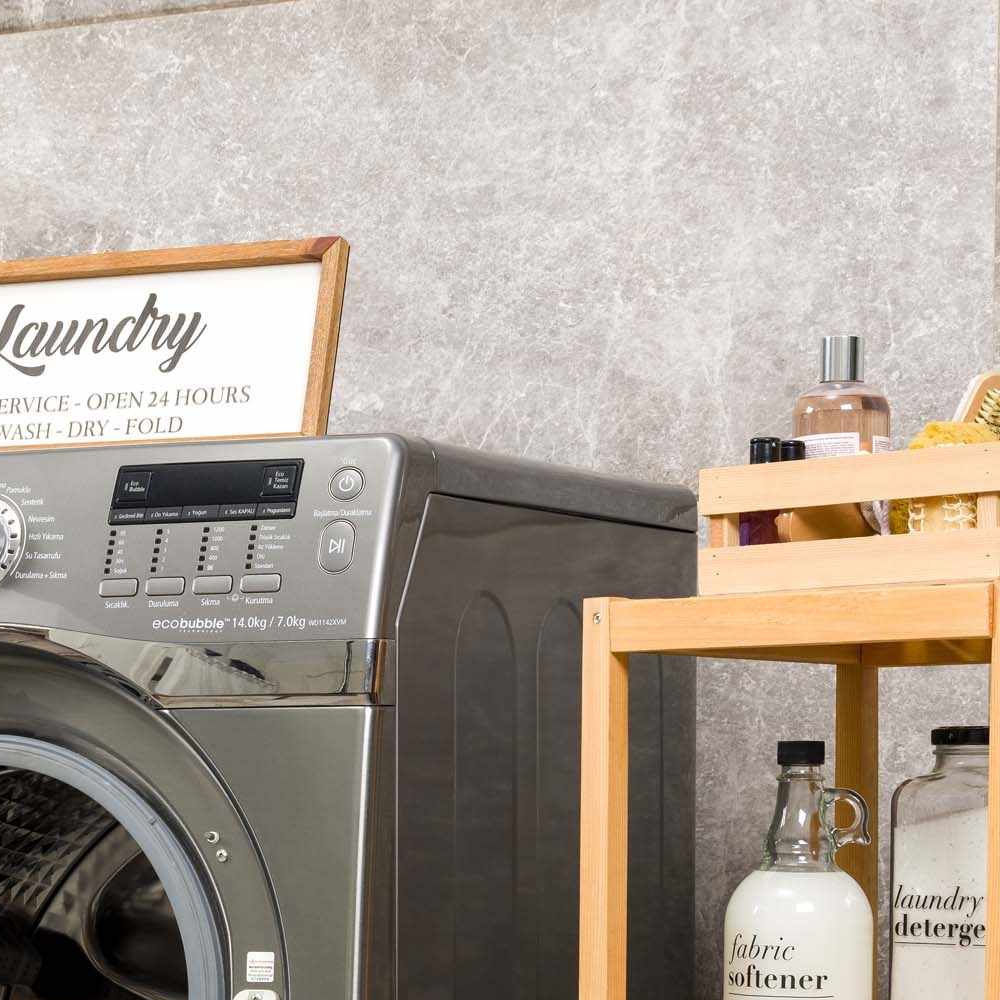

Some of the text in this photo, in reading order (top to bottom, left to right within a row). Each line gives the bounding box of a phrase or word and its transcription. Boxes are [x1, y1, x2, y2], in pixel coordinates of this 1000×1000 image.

[87, 391, 144, 411] OPEN
[148, 390, 169, 408] 24
[175, 385, 251, 407] HOURS
[68, 419, 109, 438] DRY
[126, 416, 184, 435] FOLD
[232, 617, 267, 631] 14.0kg
[277, 615, 306, 630] 7.0kg
[894, 885, 985, 919] laundry
[728, 933, 796, 964] fabric
[728, 965, 829, 990] softener
